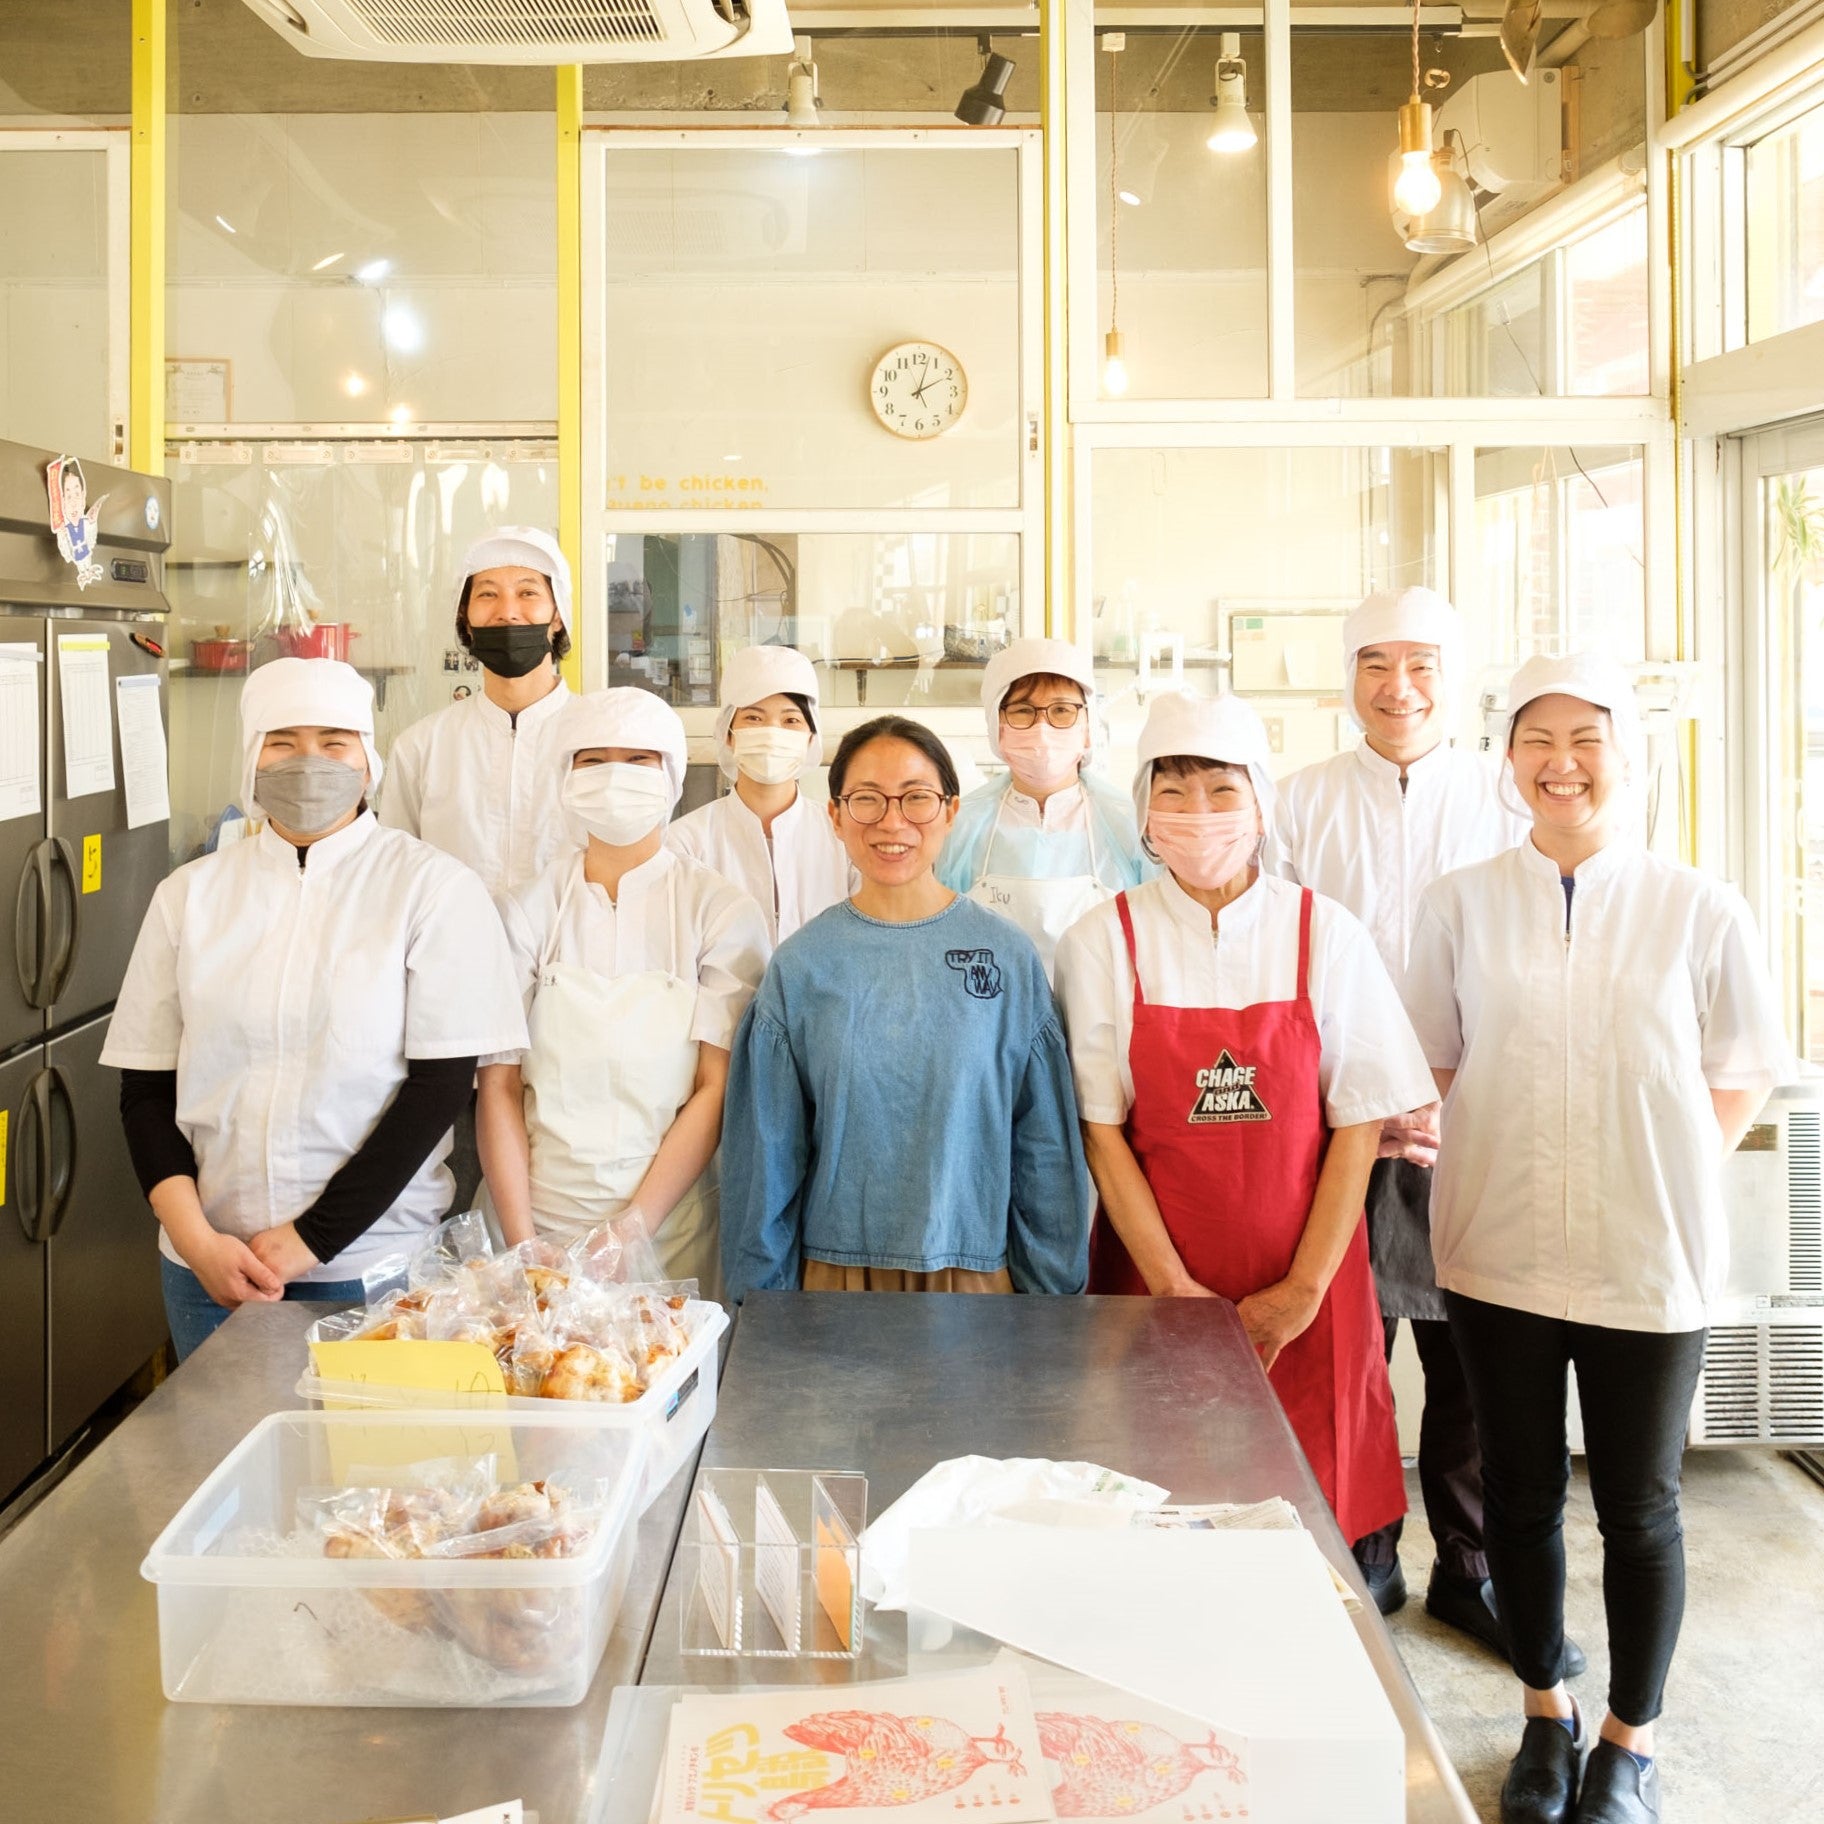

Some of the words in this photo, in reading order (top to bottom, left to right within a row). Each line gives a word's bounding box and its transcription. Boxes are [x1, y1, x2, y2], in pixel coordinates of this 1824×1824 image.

[897, 358, 908, 369] 11
[913, 353, 926, 365] 12
[885, 370, 897, 382] 10
[945, 368, 953, 380] 2
[880, 386, 888, 397] 9
[950, 386, 958, 397] 3
[885, 403, 894, 415] 8
[915, 418, 924, 430] 6
[932, 414, 940, 426] 5
[640, 475, 667, 491] be
[948, 952, 976, 963] TRY
[1195, 1066, 1257, 1089] CHAGE
[699, 1722, 760, 1824] トリセツ
